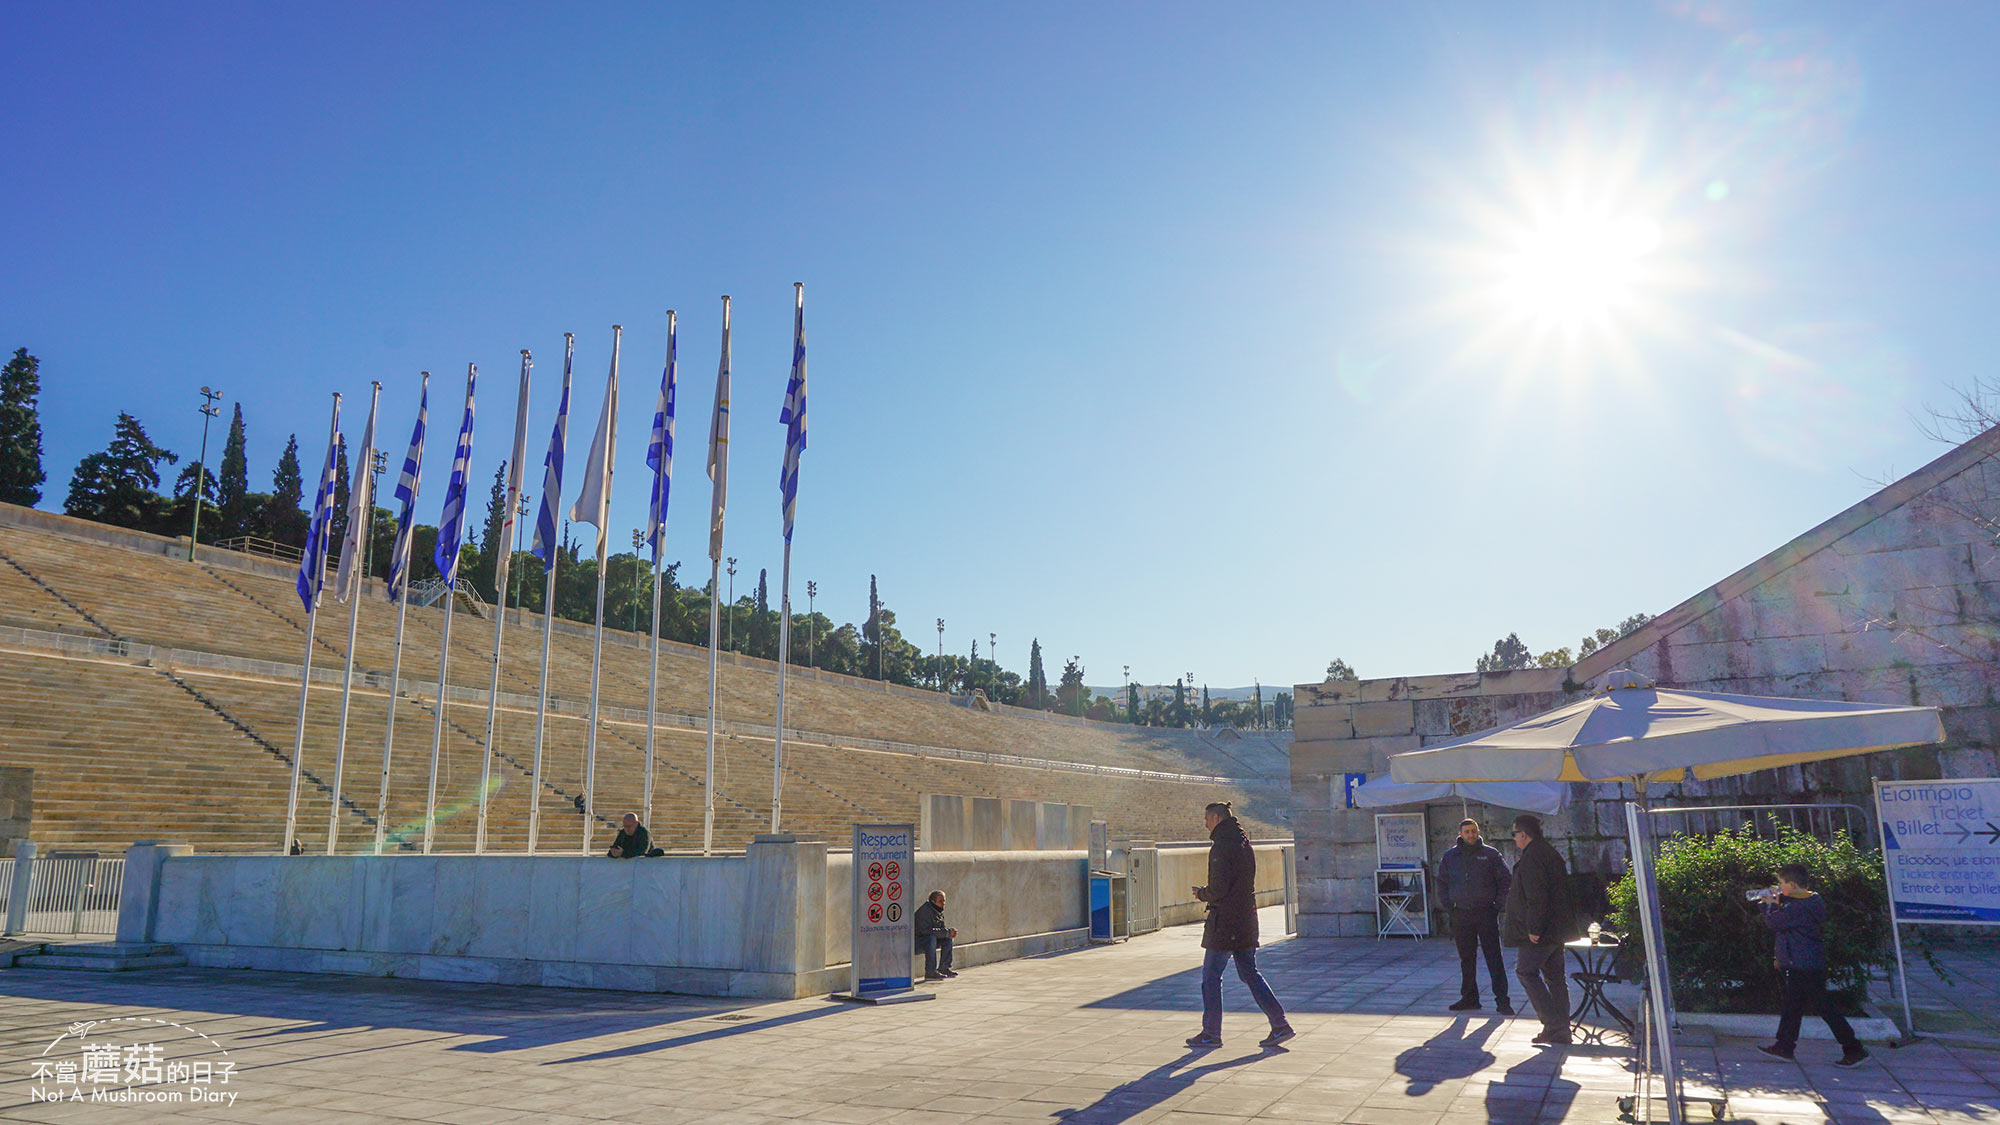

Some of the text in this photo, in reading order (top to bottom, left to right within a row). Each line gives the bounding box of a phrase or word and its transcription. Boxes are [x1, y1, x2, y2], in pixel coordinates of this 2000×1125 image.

[1881, 785, 1973, 804] Εισιτήριο
[1928, 804, 1985, 820] Ticket
[1896, 820, 1941, 835] Billet
[860, 832, 908, 849] Respect
[860, 850, 908, 860] monument
[1900, 868, 1995, 881] Ticket entrance
[1944, 885, 1965, 896] par
